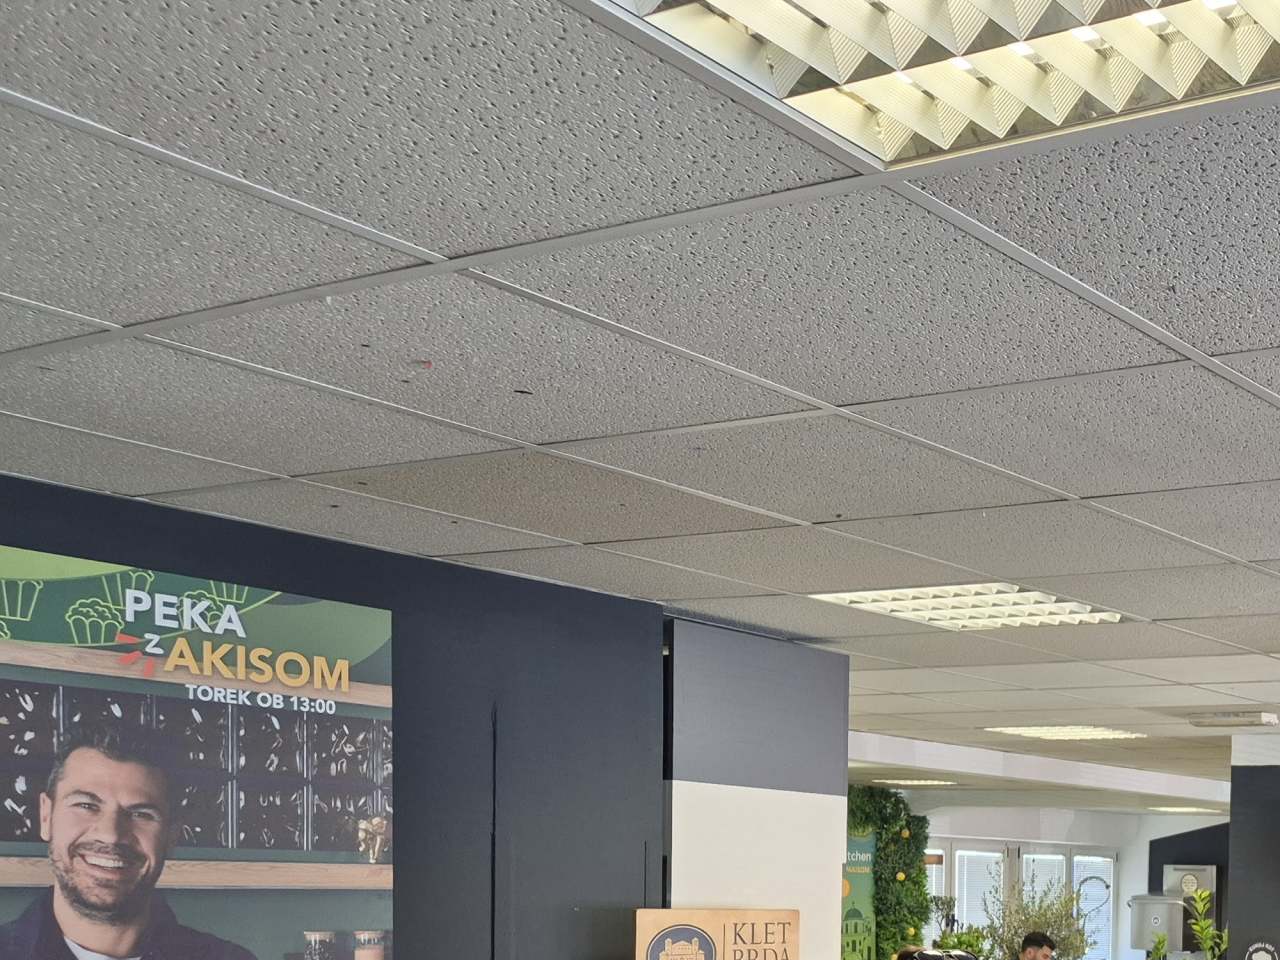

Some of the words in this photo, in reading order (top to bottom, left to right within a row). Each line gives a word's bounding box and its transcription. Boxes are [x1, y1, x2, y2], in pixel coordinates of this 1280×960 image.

[125, 588, 247, 638] PEKA
[163, 637, 350, 693] AKISOM
[185, 683, 252, 706] TOREK
[256, 691, 284, 710] OB
[289, 695, 337, 715] 13:00
[732, 922, 792, 945] KLET
